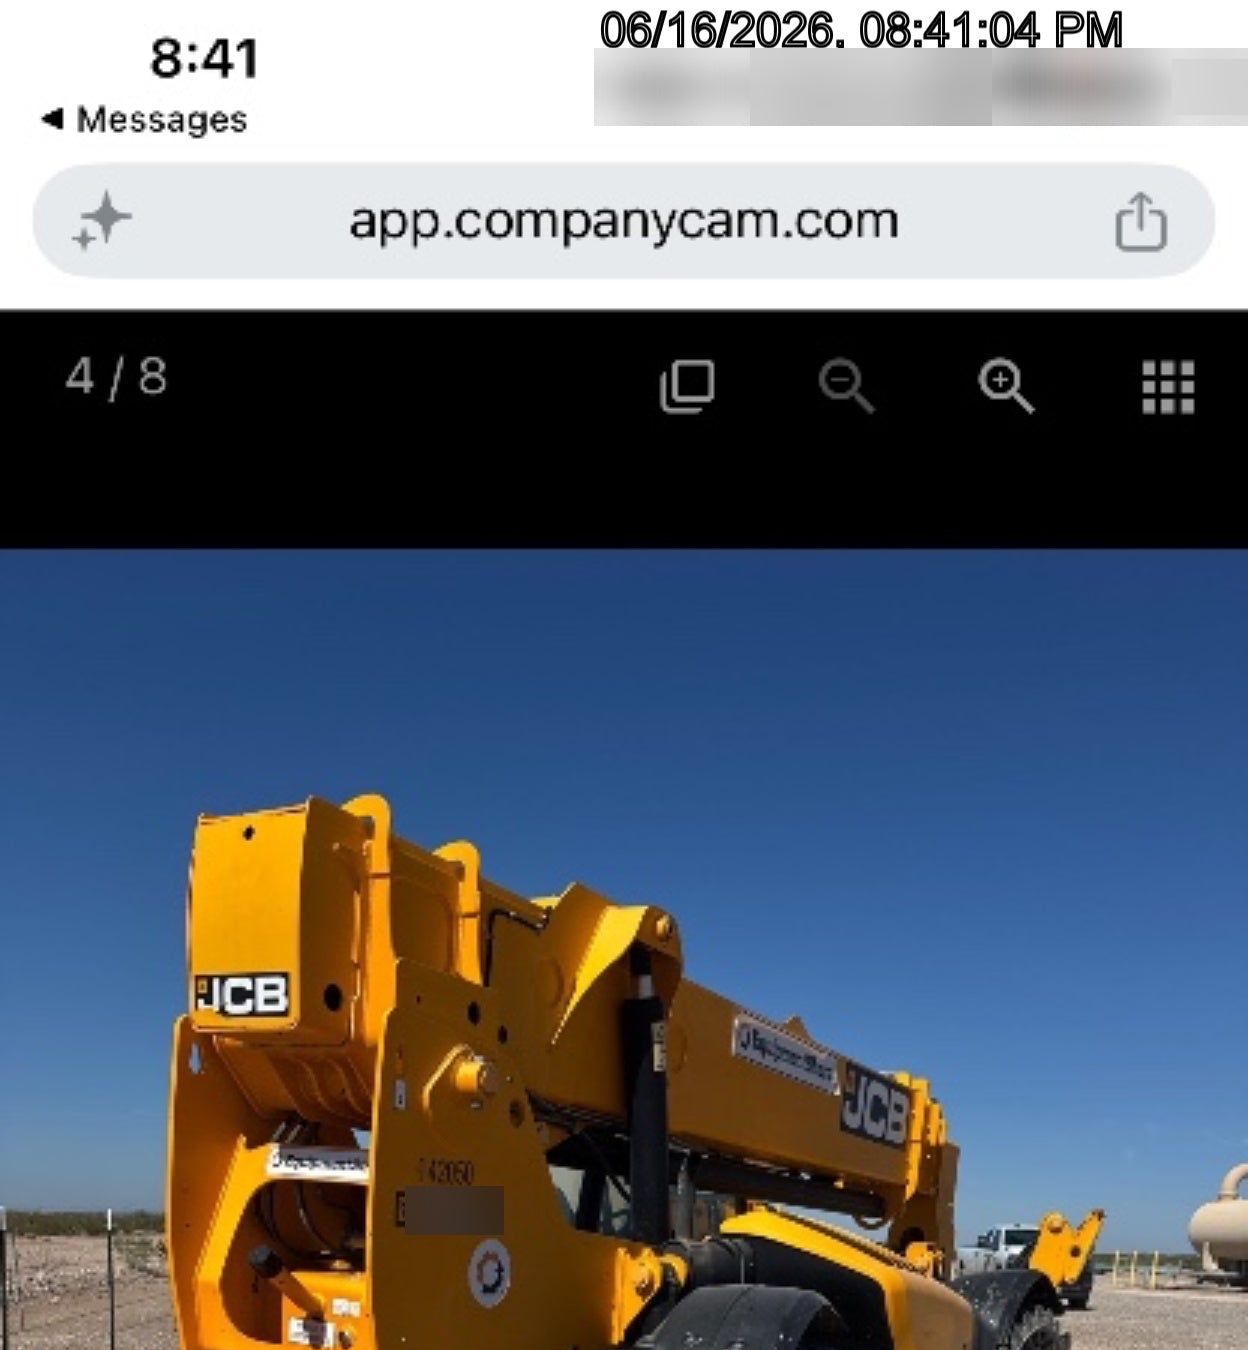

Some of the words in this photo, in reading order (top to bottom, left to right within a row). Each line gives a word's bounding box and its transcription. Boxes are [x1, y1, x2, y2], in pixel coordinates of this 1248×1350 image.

[151, 37, 257, 79] 8:41
[77, 105, 248, 139] Messages
[350, 203, 899, 249] app.companycam.com
[65, 356, 95, 394] 4
[139, 356, 167, 394] 8
[196, 975, 288, 1014] JCB
[842, 1068, 910, 1144] JCB
